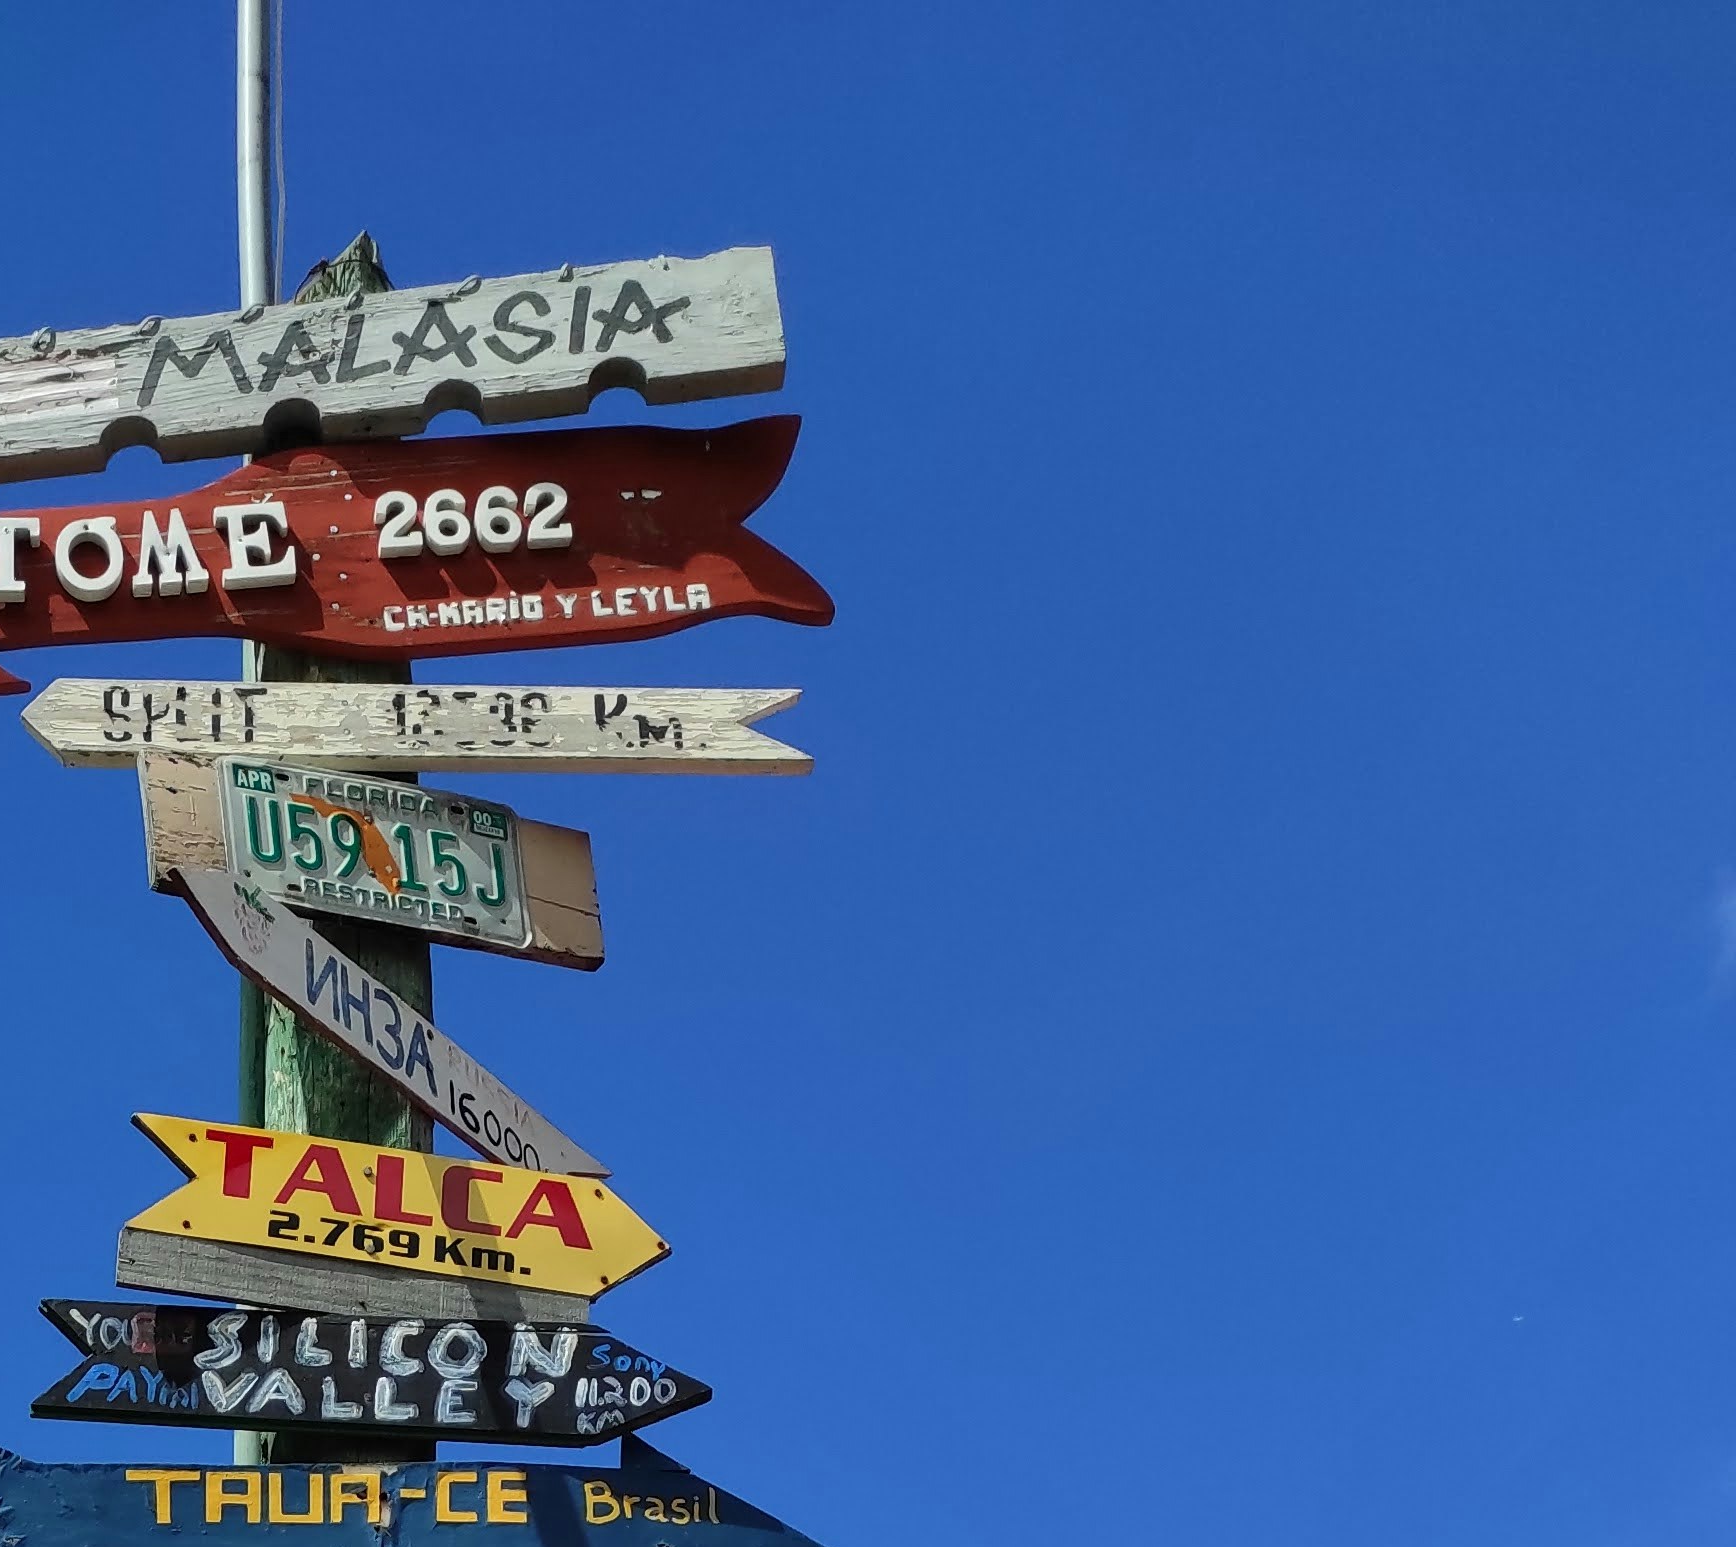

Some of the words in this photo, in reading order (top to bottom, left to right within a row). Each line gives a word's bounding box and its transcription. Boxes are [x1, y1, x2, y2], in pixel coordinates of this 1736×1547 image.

[138, 278, 692, 408] MALASIA
[374, 483, 572, 559] 2662
[556, 592, 578, 619] Y
[591, 584, 710, 617] LEYLA
[236, 770, 273, 792] APR
[302, 775, 439, 815] FLORIDA
[243, 794, 363, 878] U59
[392, 823, 506, 907] 15J
[301, 877, 463, 921] RESTRICTED
[304, 937, 437, 1097] ИНЗА
[205, 1128, 593, 1251] TALCA
[267, 1209, 420, 1260] 2.769
[433, 1236, 532, 1276] Km.
[192, 1310, 579, 1379] SILICON
[586, 1343, 667, 1381] Sony
[201, 1366, 555, 1430] VALLEY
[583, 1480, 720, 1525] Brasil
